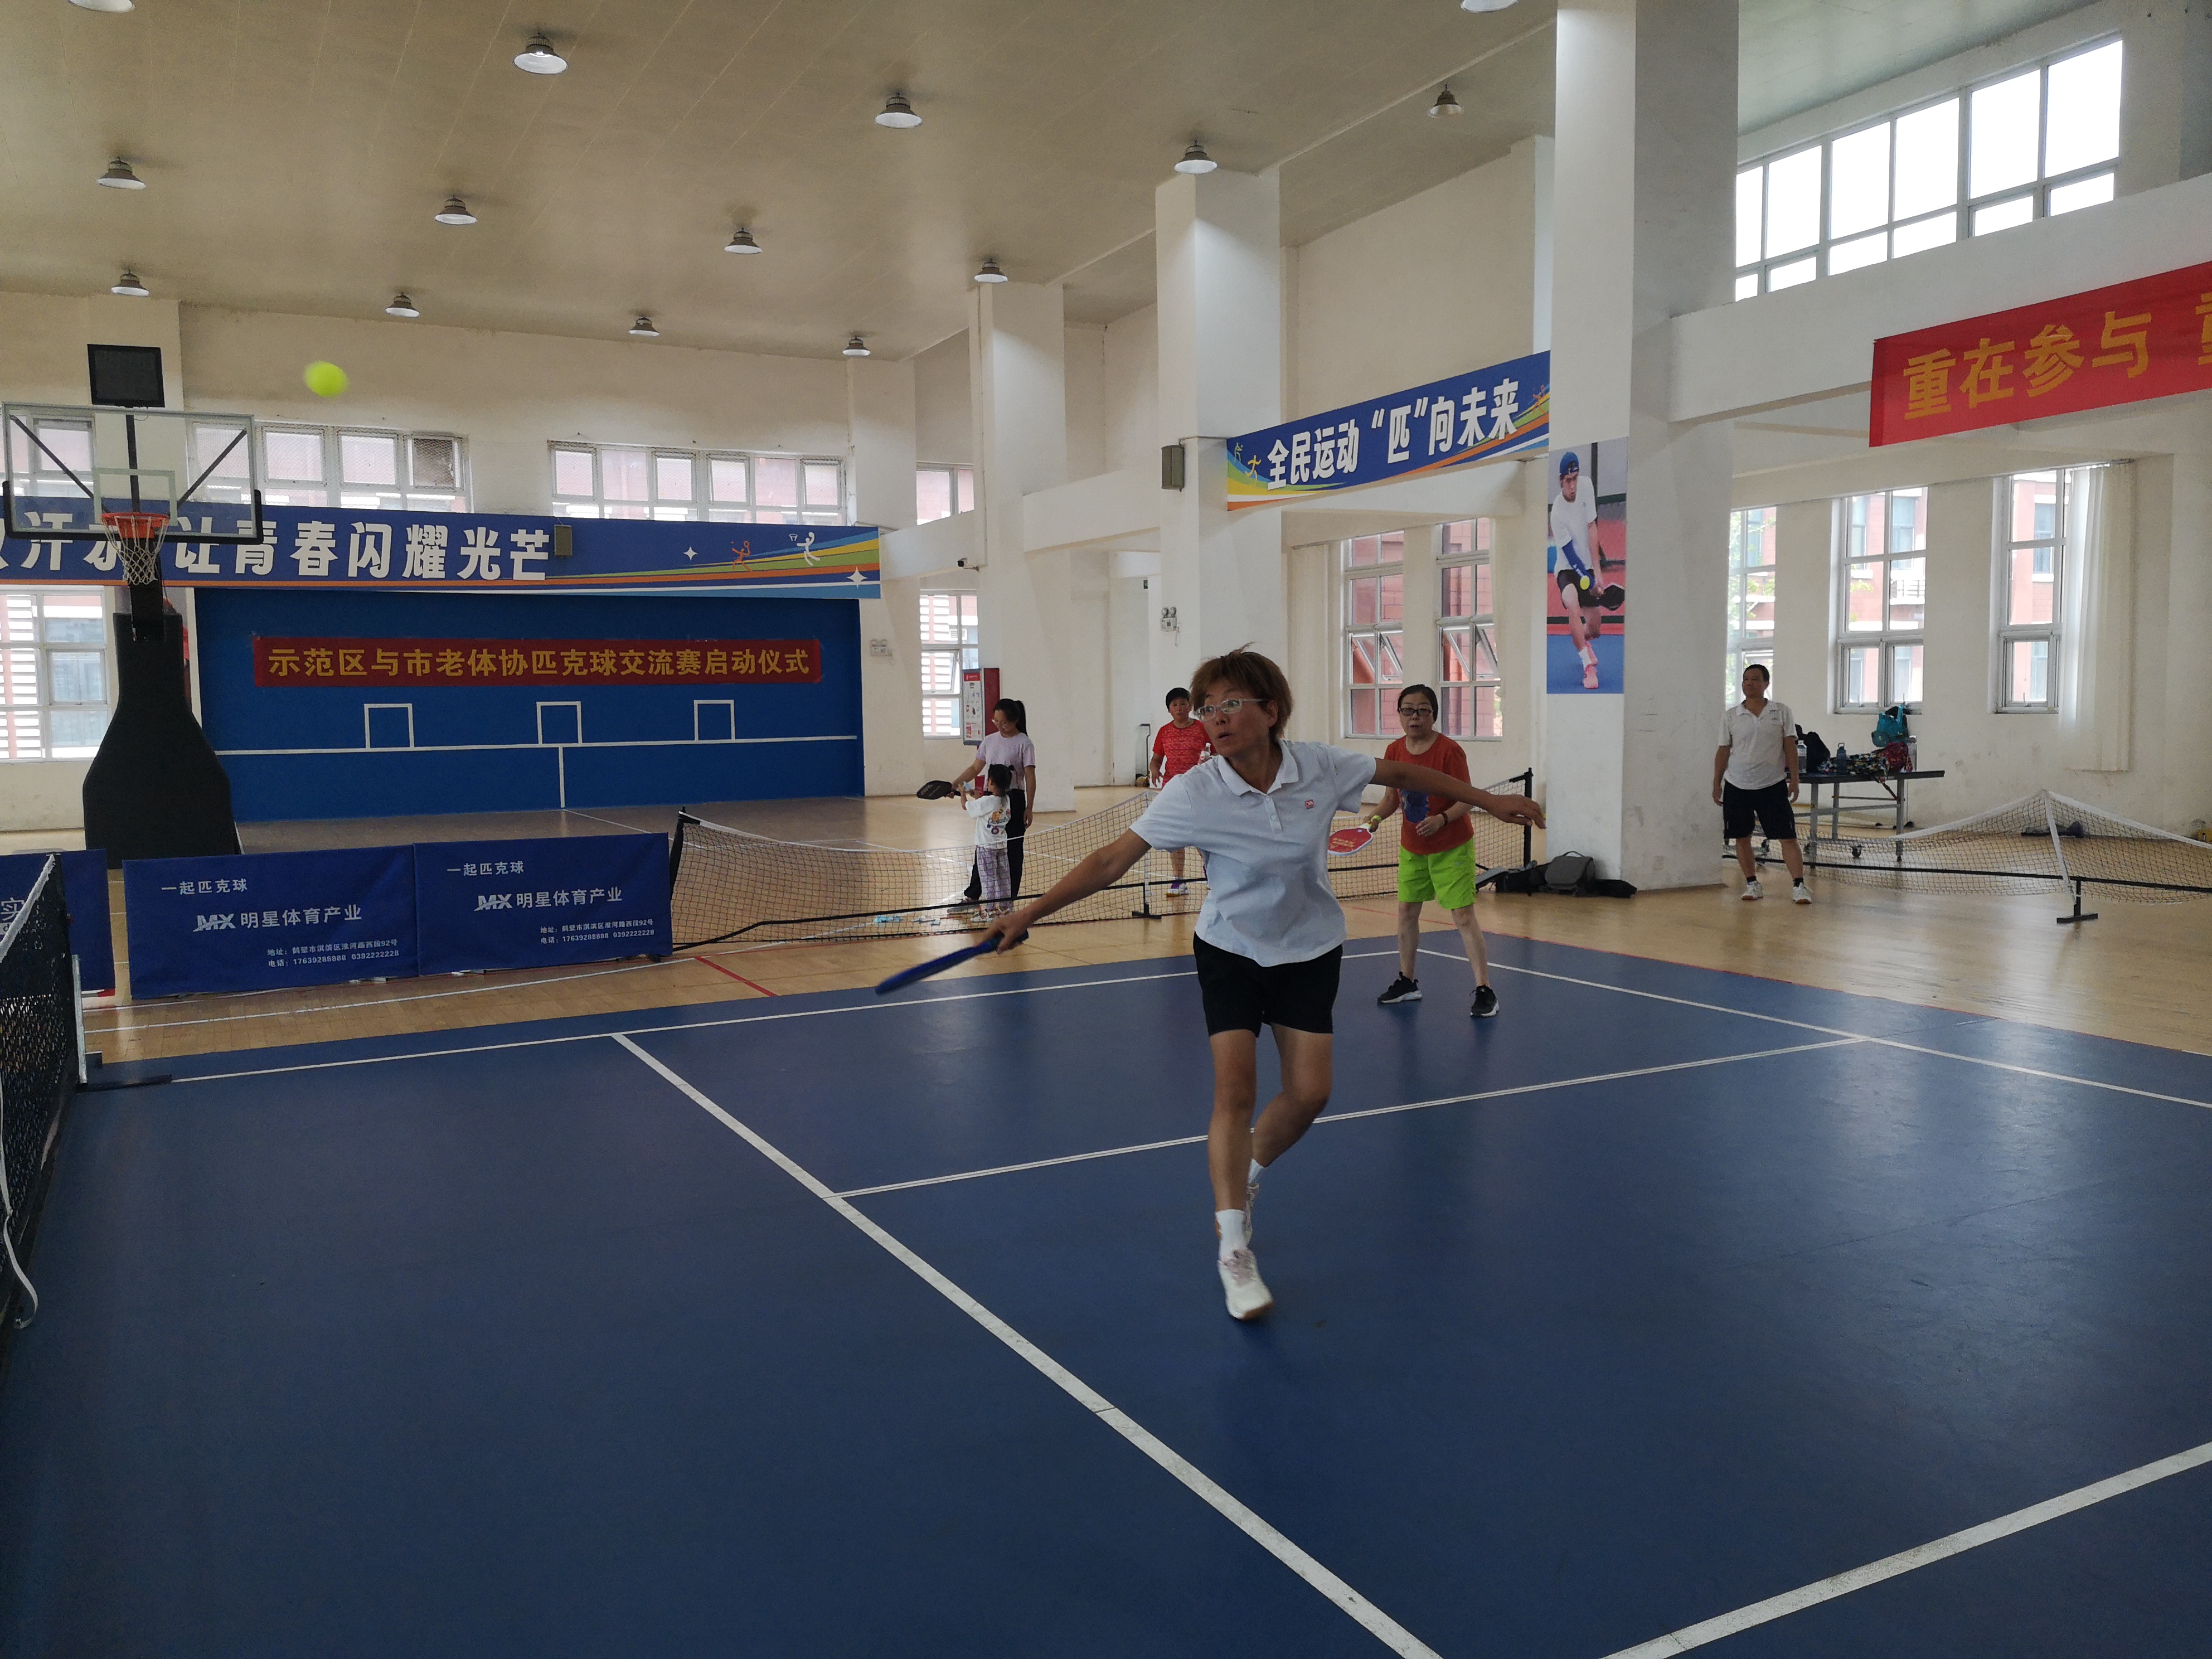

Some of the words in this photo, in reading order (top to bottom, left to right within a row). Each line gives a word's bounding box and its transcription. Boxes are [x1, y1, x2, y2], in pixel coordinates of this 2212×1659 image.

[1903, 311, 2152, 420] 重在参与
[268, 648, 809, 677] 示范区与市老体协匹克球交流赛启动仪式
[448, 861, 525, 876] 一起匹克球
[161, 879, 248, 895] 一起匹克球
[474, 894, 513, 911] MX
[516, 887, 623, 909] 明星体育产业
[193, 913, 236, 932] MX
[240, 904, 362, 929] 明星体育产业
